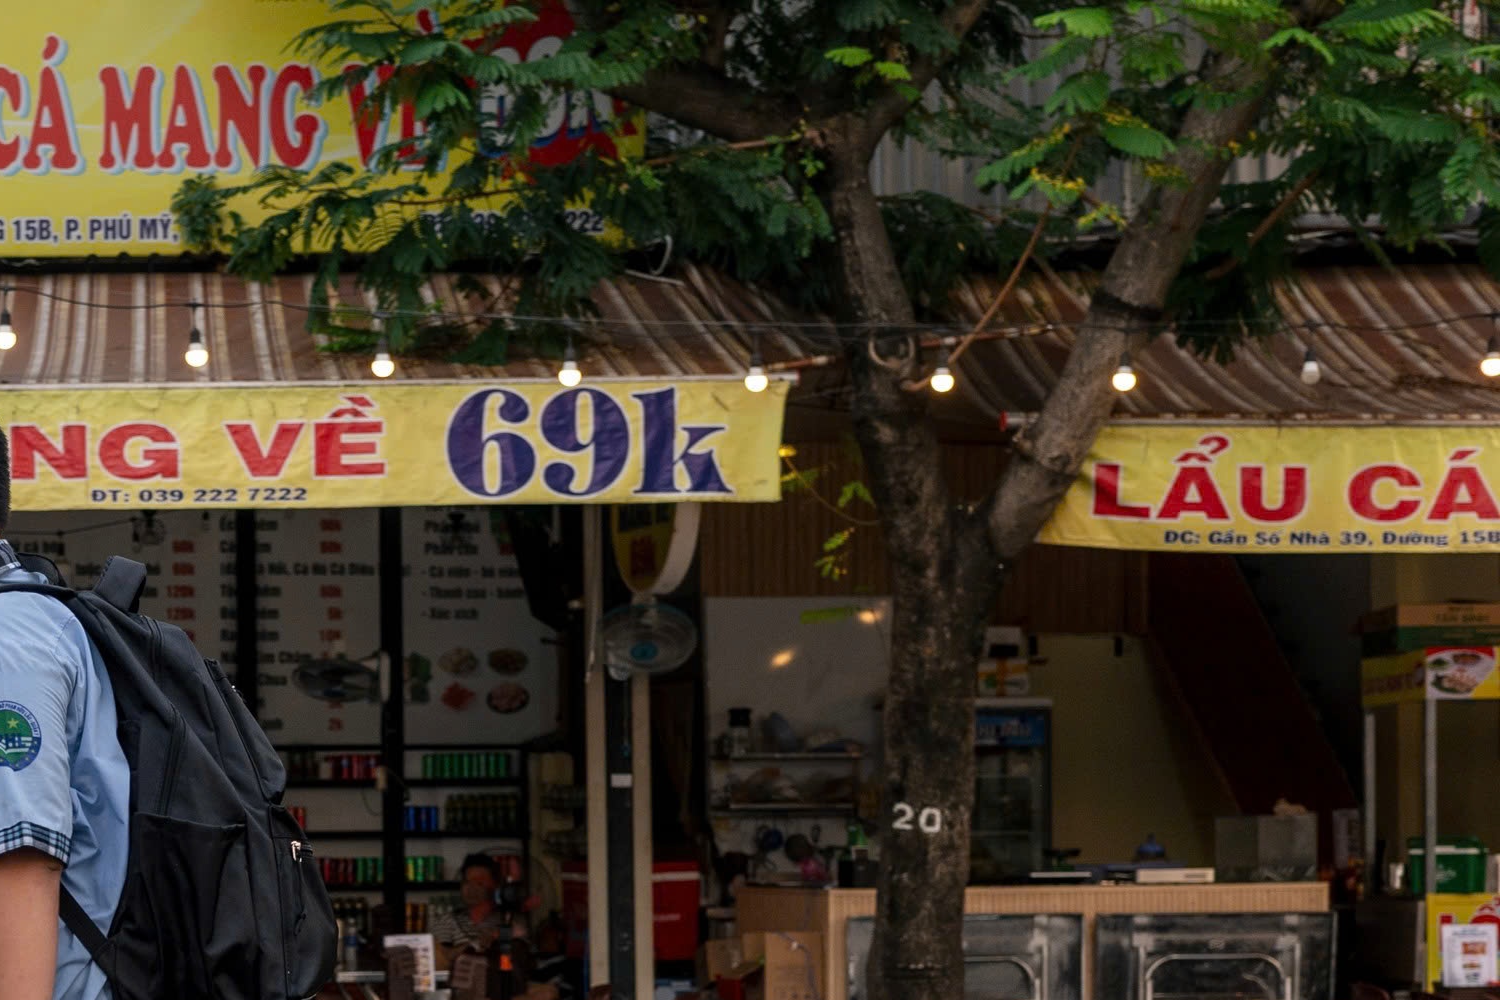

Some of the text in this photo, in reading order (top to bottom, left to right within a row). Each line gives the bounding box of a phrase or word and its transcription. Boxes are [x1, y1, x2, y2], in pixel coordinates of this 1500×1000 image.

[99, 63, 322, 171] MANG
[13, 219, 59, 243] 15B,
[66, 219, 83, 240] P.
[90, 214, 132, 240] PHÚ
[140, 214, 180, 242] MỸ,
[11, 423, 182, 480] NG
[224, 395, 387, 478] VỀ
[446, 386, 735, 497] 69k
[1092, 434, 1500, 522] LẨU CÁ
[91, 487, 308, 503] ĐT: 039 222 7222
[1289, 530, 1330, 545] Nhà
[1340, 531, 1373, 547] 39,
[891, 801, 941, 833] 20
